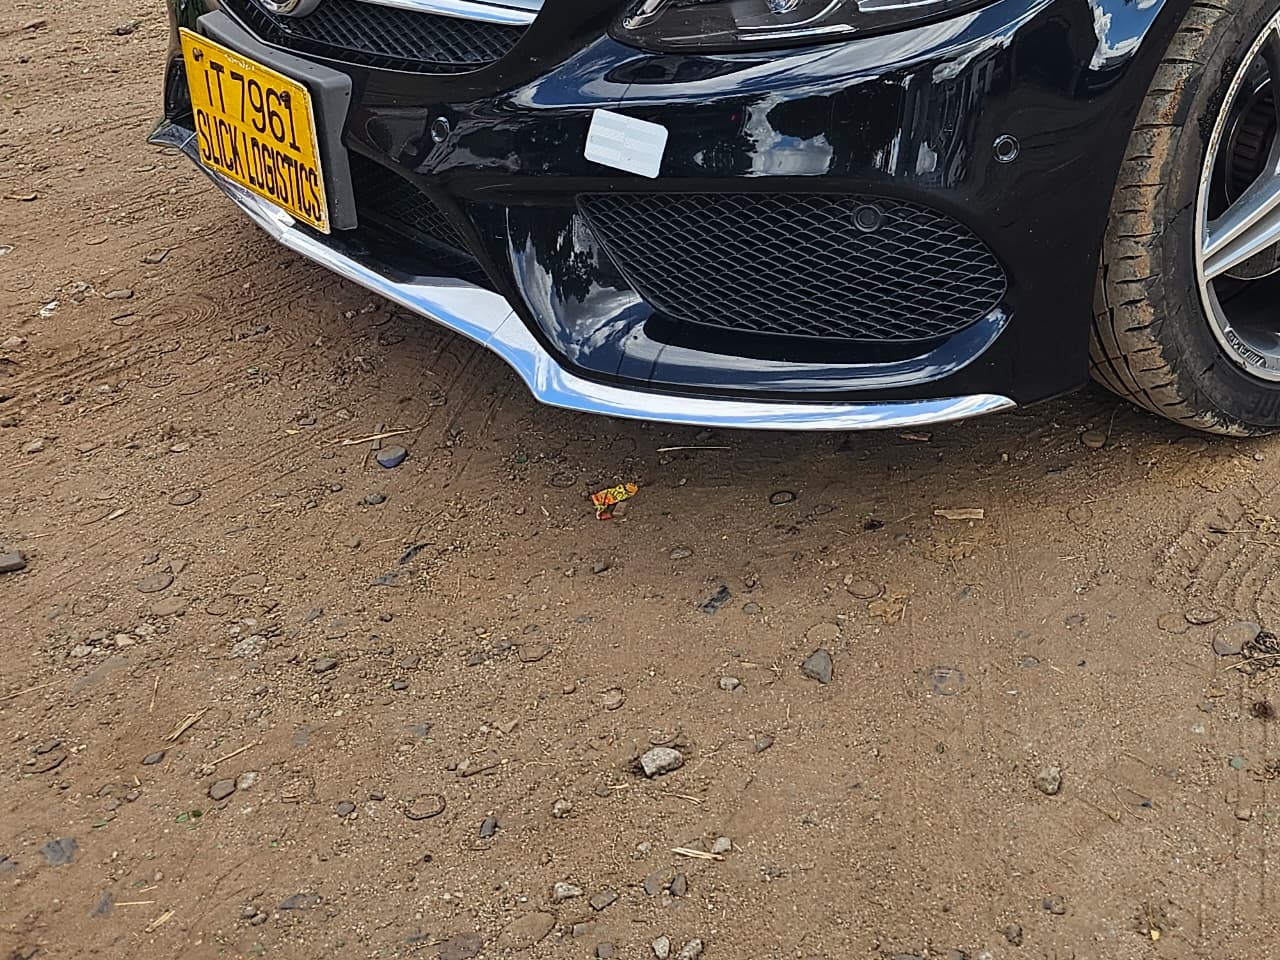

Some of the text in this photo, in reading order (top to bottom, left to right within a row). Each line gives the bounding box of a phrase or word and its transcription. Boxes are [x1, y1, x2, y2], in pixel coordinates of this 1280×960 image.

[230, 71, 301, 153] 7961
[196, 108, 322, 222] SLICK LOGISTICS
